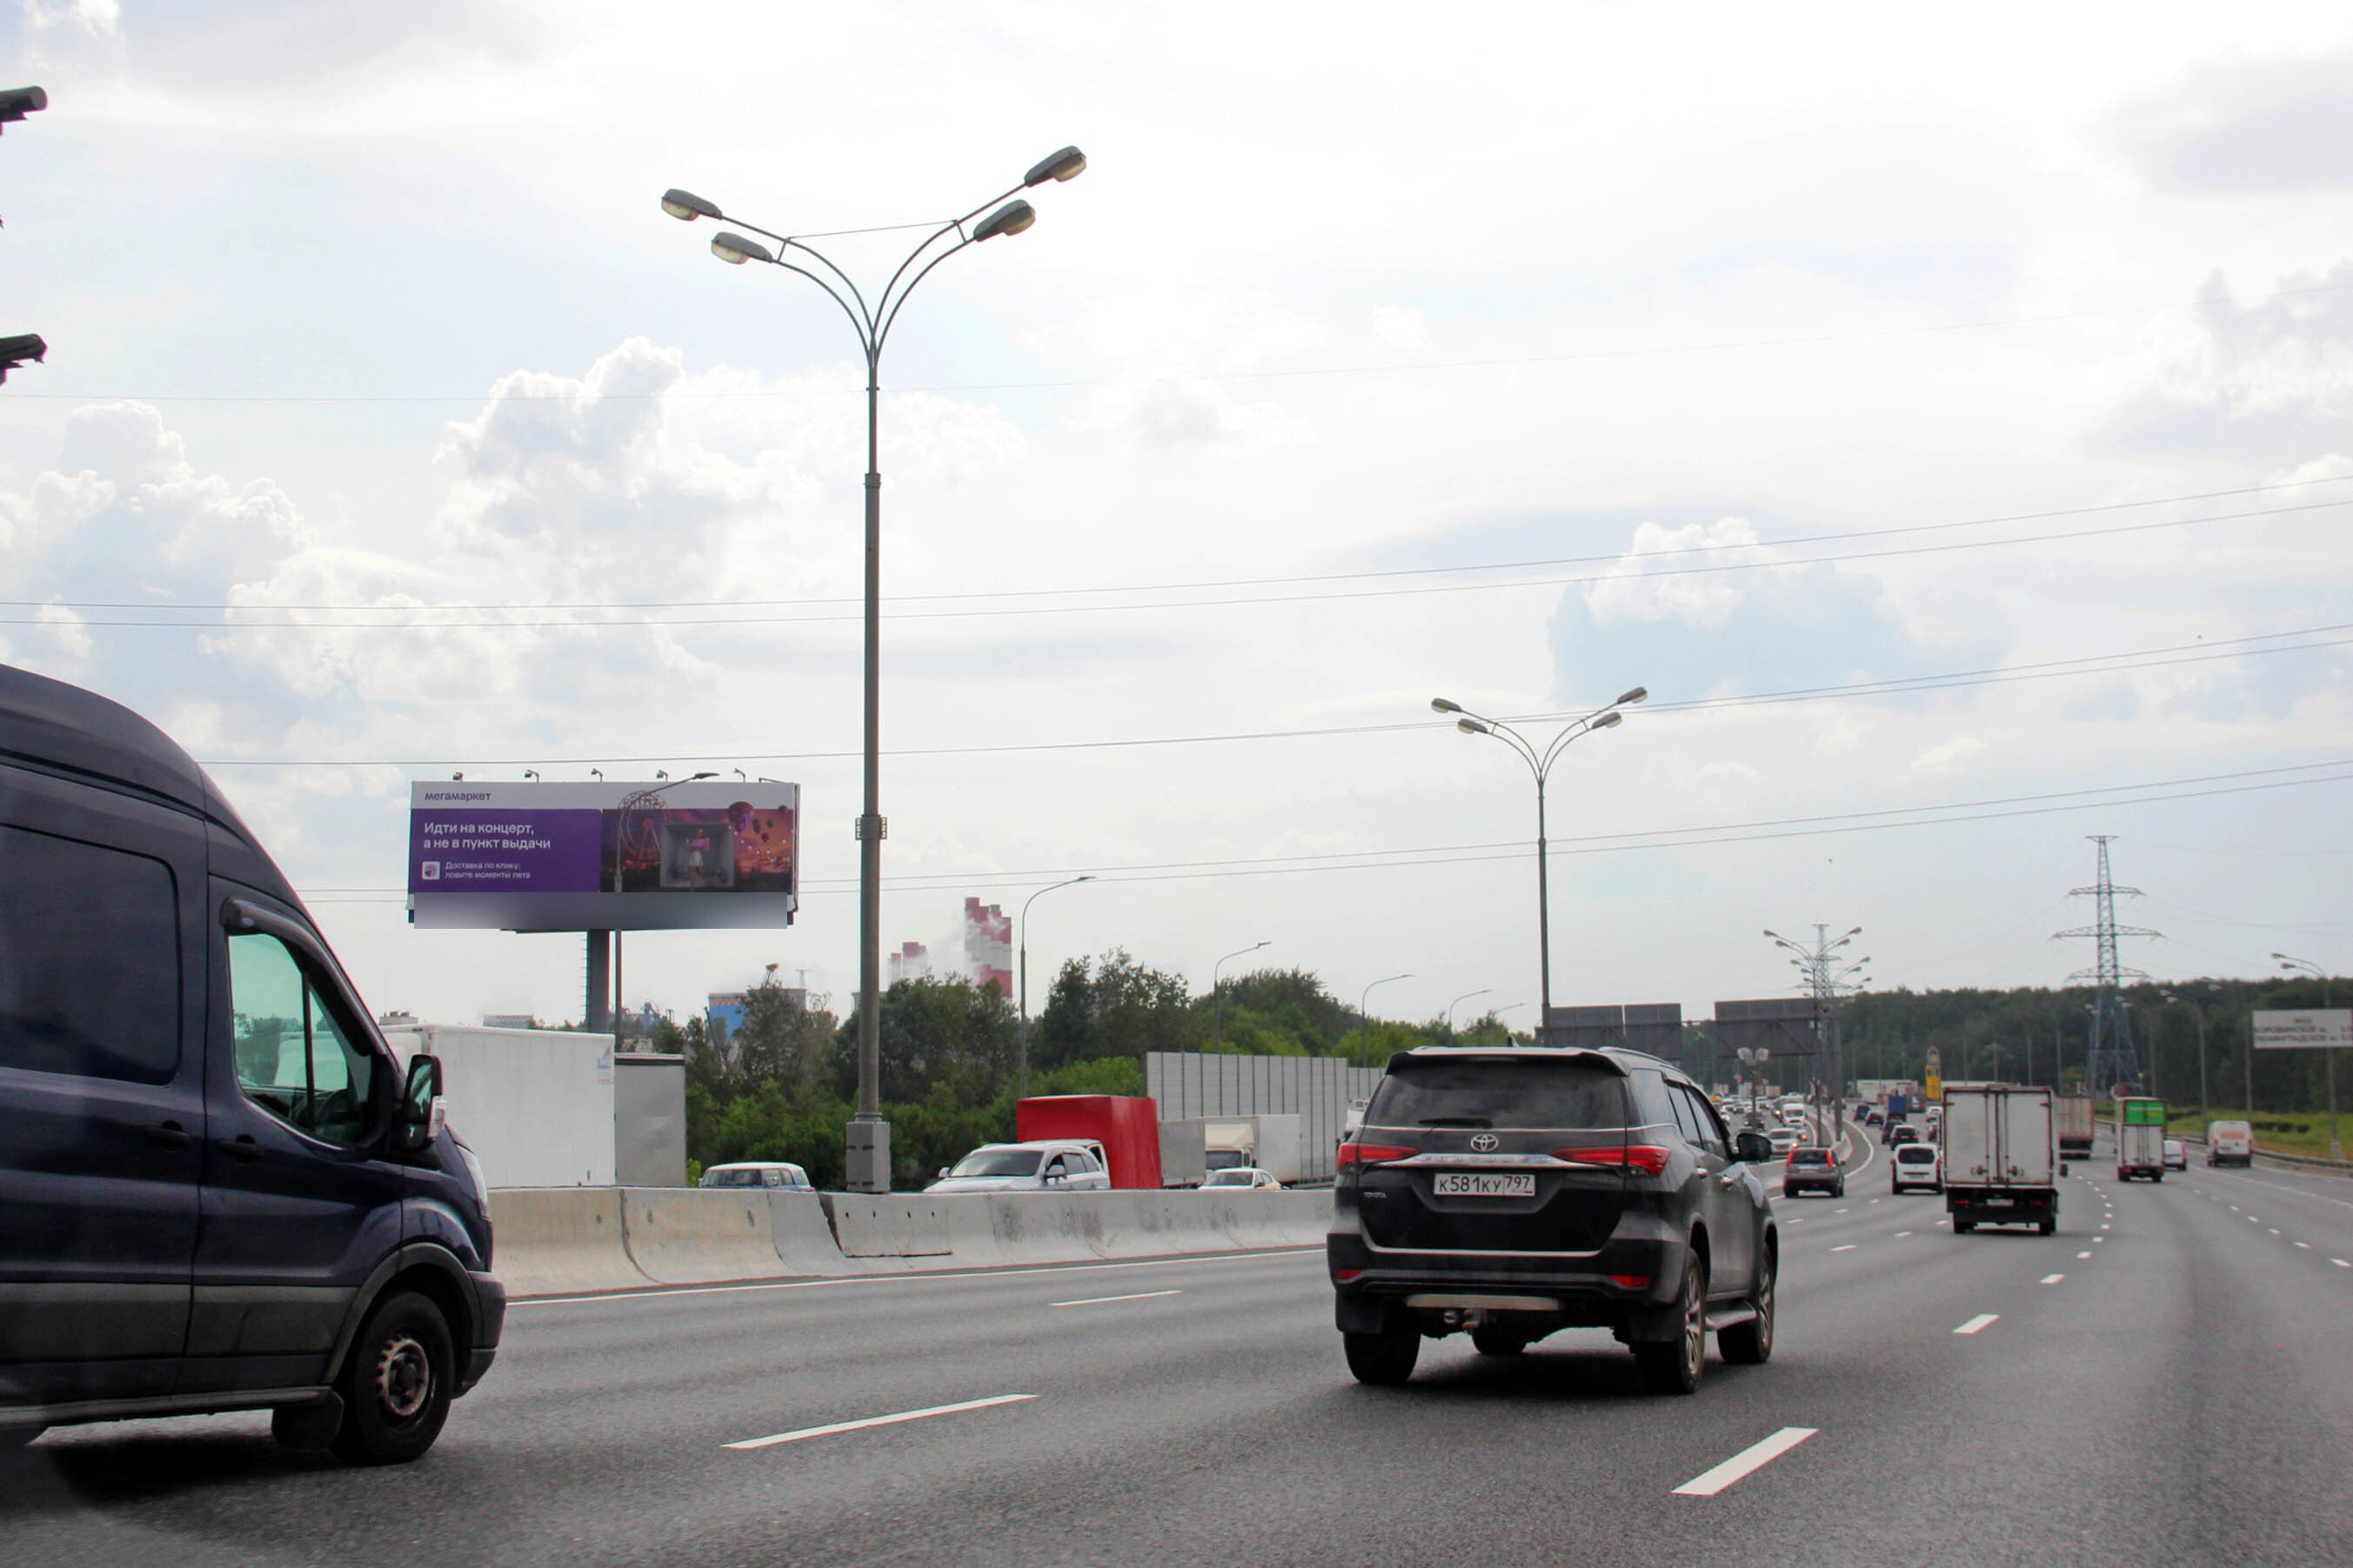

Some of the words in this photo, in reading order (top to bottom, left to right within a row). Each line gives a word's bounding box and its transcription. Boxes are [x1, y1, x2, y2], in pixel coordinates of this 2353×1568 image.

[424, 792, 491, 802] мегамаркет
[424, 822, 458, 835] Идти
[460, 824, 476, 833] на
[478, 824, 535, 835] концерт,
[423, 839, 431, 849] а
[433, 839, 450, 849] не
[451, 839, 460, 849] в
[462, 839, 500, 851] пункт
[502, 839, 551, 851] выдачи
[445, 861, 484, 871] Доставка
